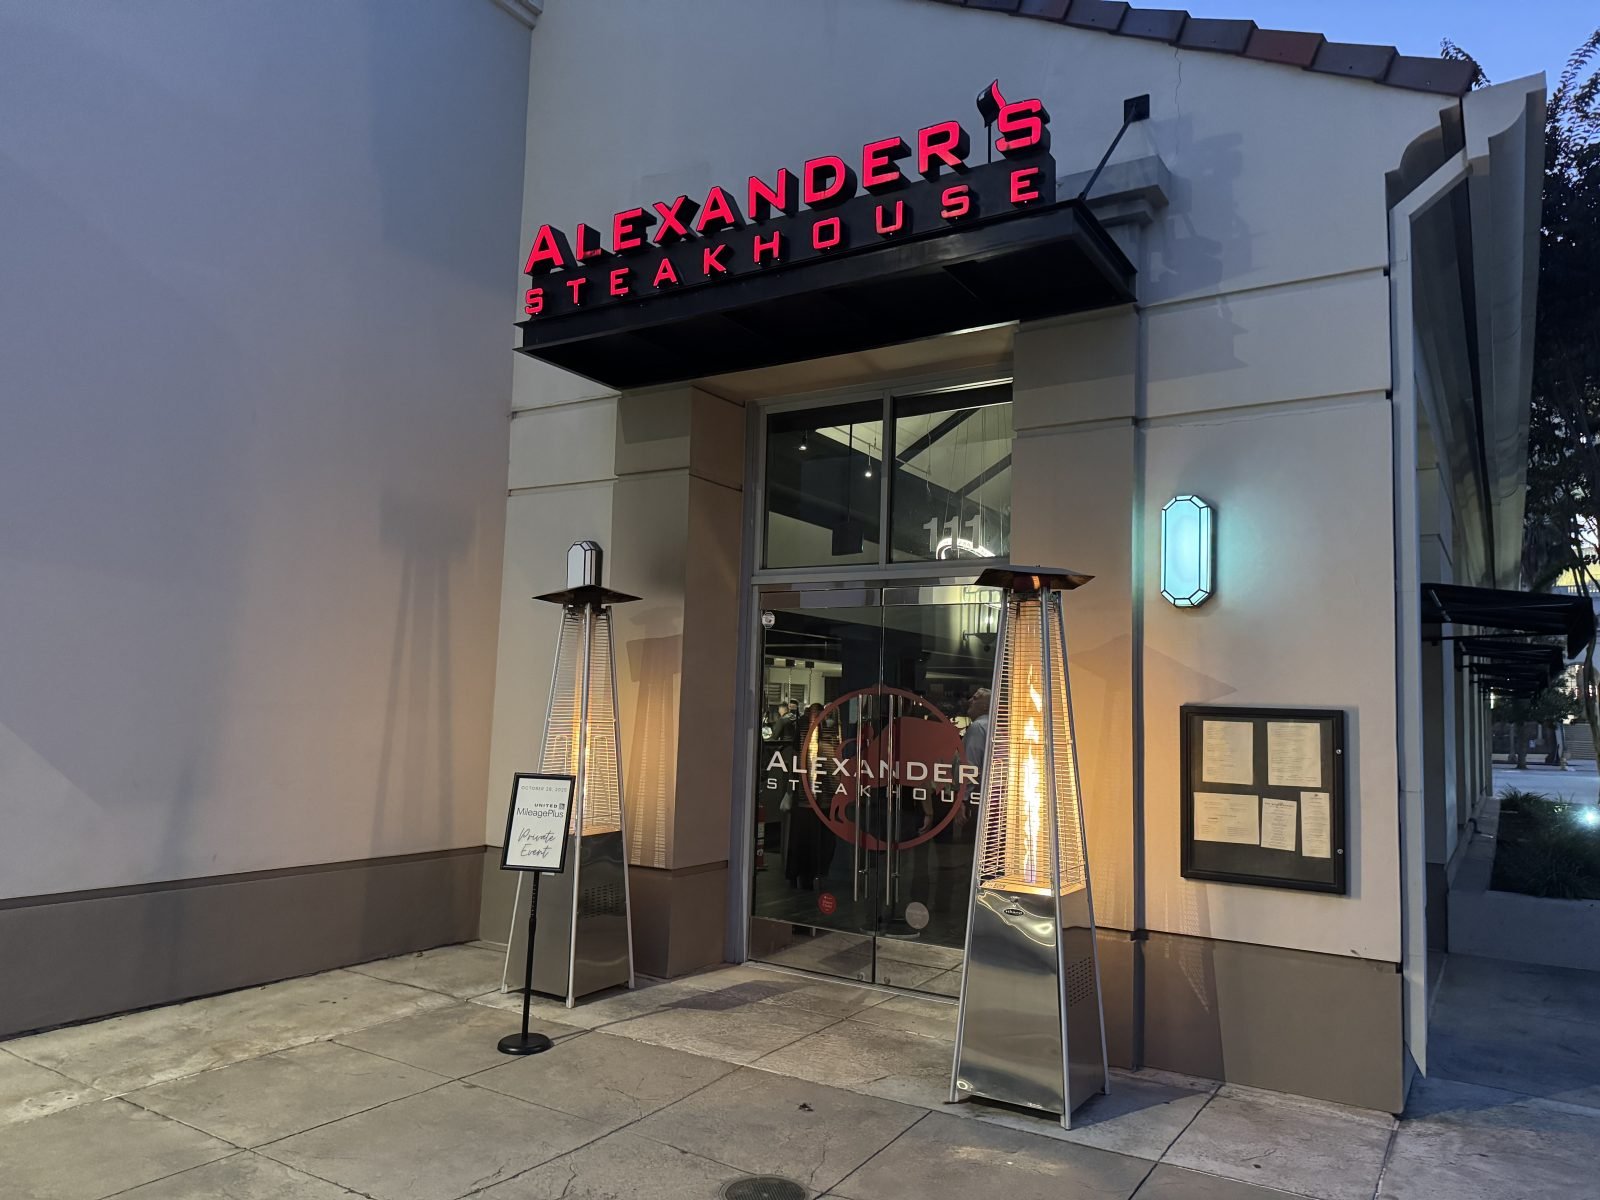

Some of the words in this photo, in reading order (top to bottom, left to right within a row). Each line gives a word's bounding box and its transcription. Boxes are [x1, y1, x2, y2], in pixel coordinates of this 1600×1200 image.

[524, 79, 1044, 275] ALEXANDER'S
[525, 167, 1040, 315] STEAKHOUSE
[923, 515, 981, 553] 111
[766, 750, 979, 785] ALEXANDER
[516, 807, 564, 818] MileagePlus
[518, 828, 556, 843] Private
[520, 844, 552, 859] Event
